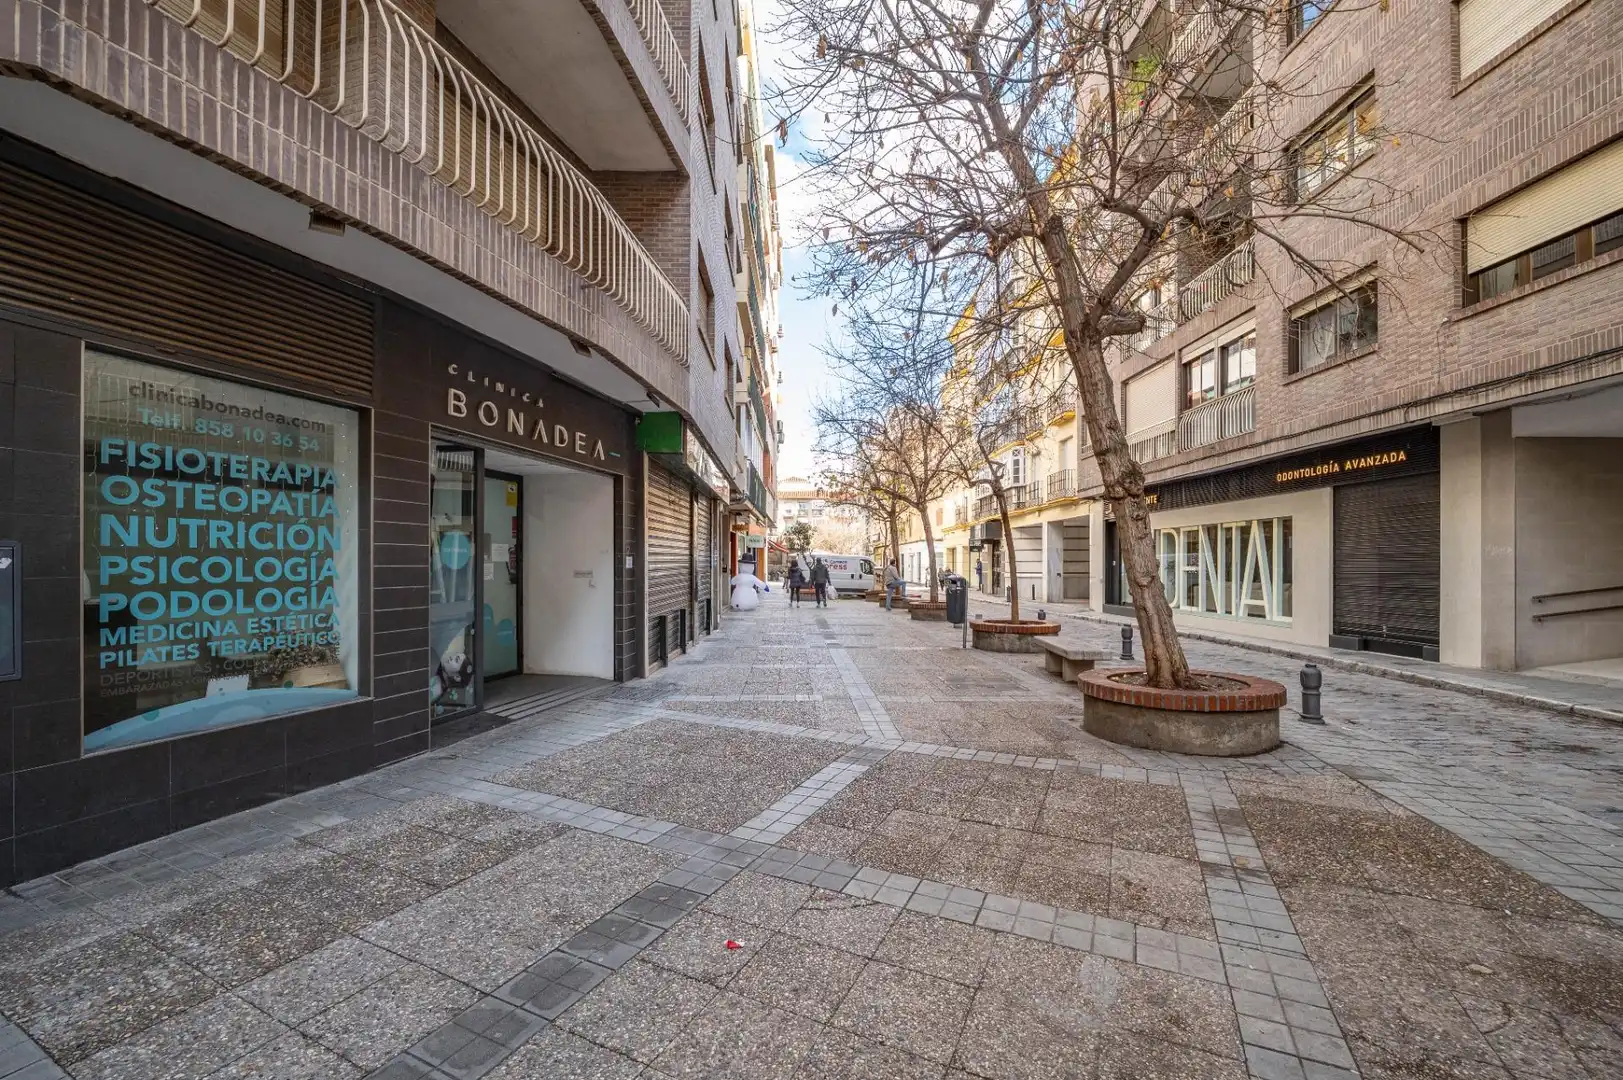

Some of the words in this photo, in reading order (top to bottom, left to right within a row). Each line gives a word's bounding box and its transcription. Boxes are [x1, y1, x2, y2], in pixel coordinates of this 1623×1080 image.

[448, 363, 544, 408] CLINICA
[128, 381, 326, 433] clinicabonadea.com
[448, 387, 605, 461] BONADEA
[194, 417, 235, 438] 858
[243, 426, 265, 443] 10
[271, 432, 294, 448] 36
[298, 436, 320, 452] 54
[1276, 460, 1340, 483] ODONTOLOGÍA
[1345, 450, 1407, 471] AVANZADA
[101, 474, 340, 518] OSTEOPATÍA
[100, 513, 342, 552] NUTRICIÓN
[100, 551, 340, 586] PSICOLOGÍA
[99, 580, 340, 622] PODOLOGÍA
[100, 619, 239, 647] MEDICINA
[247, 612, 340, 634] ESTÉTICA
[100, 642, 201, 669] PILATES
[207, 630, 341, 657] TERAPÉUTICO
[100, 661, 213, 687] DEPORTISTAS
[100, 678, 184, 698] EMBARAZADAS
